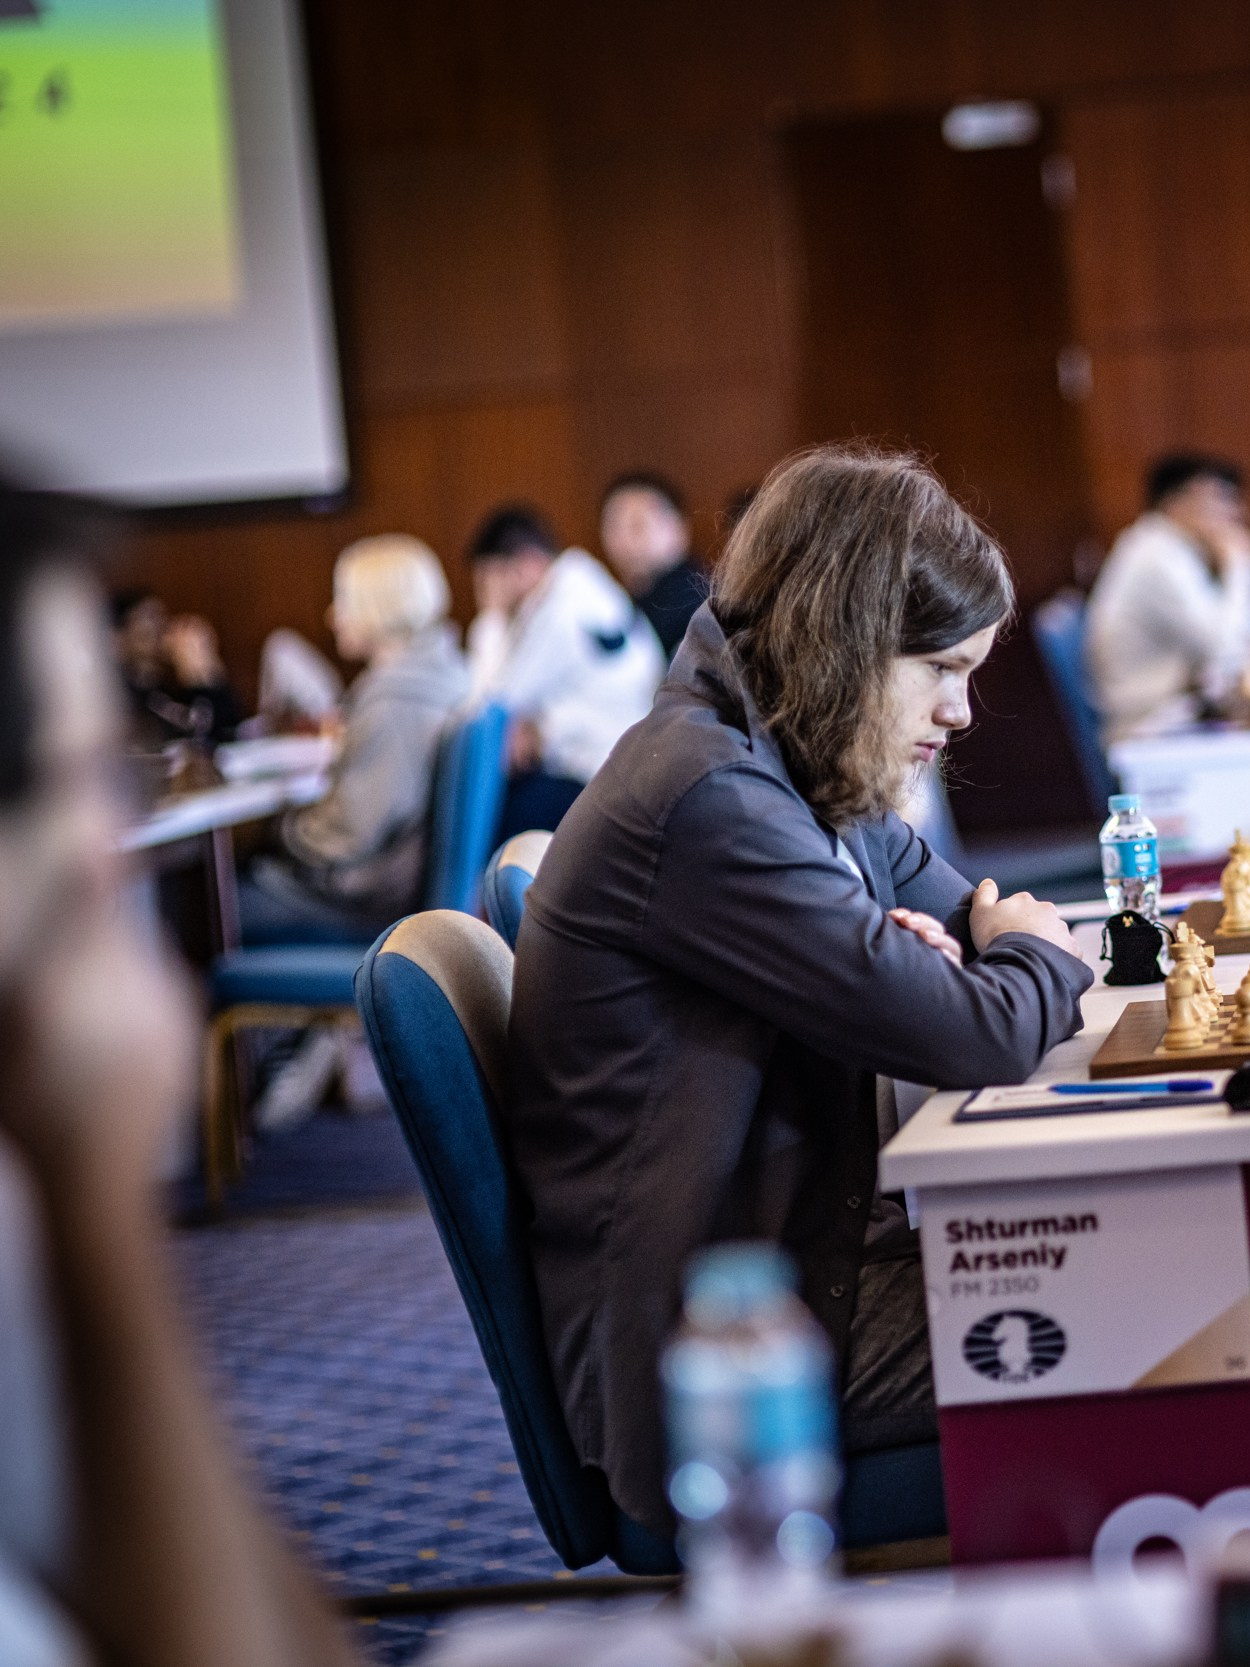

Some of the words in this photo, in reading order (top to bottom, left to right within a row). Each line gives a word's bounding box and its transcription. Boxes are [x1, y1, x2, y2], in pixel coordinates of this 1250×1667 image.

[945, 1211, 1099, 1245] Shturman
[949, 1243, 1068, 1274] Arseniy
[950, 1279, 983, 1299] FM
[988, 1275, 1040, 1296] 2350
